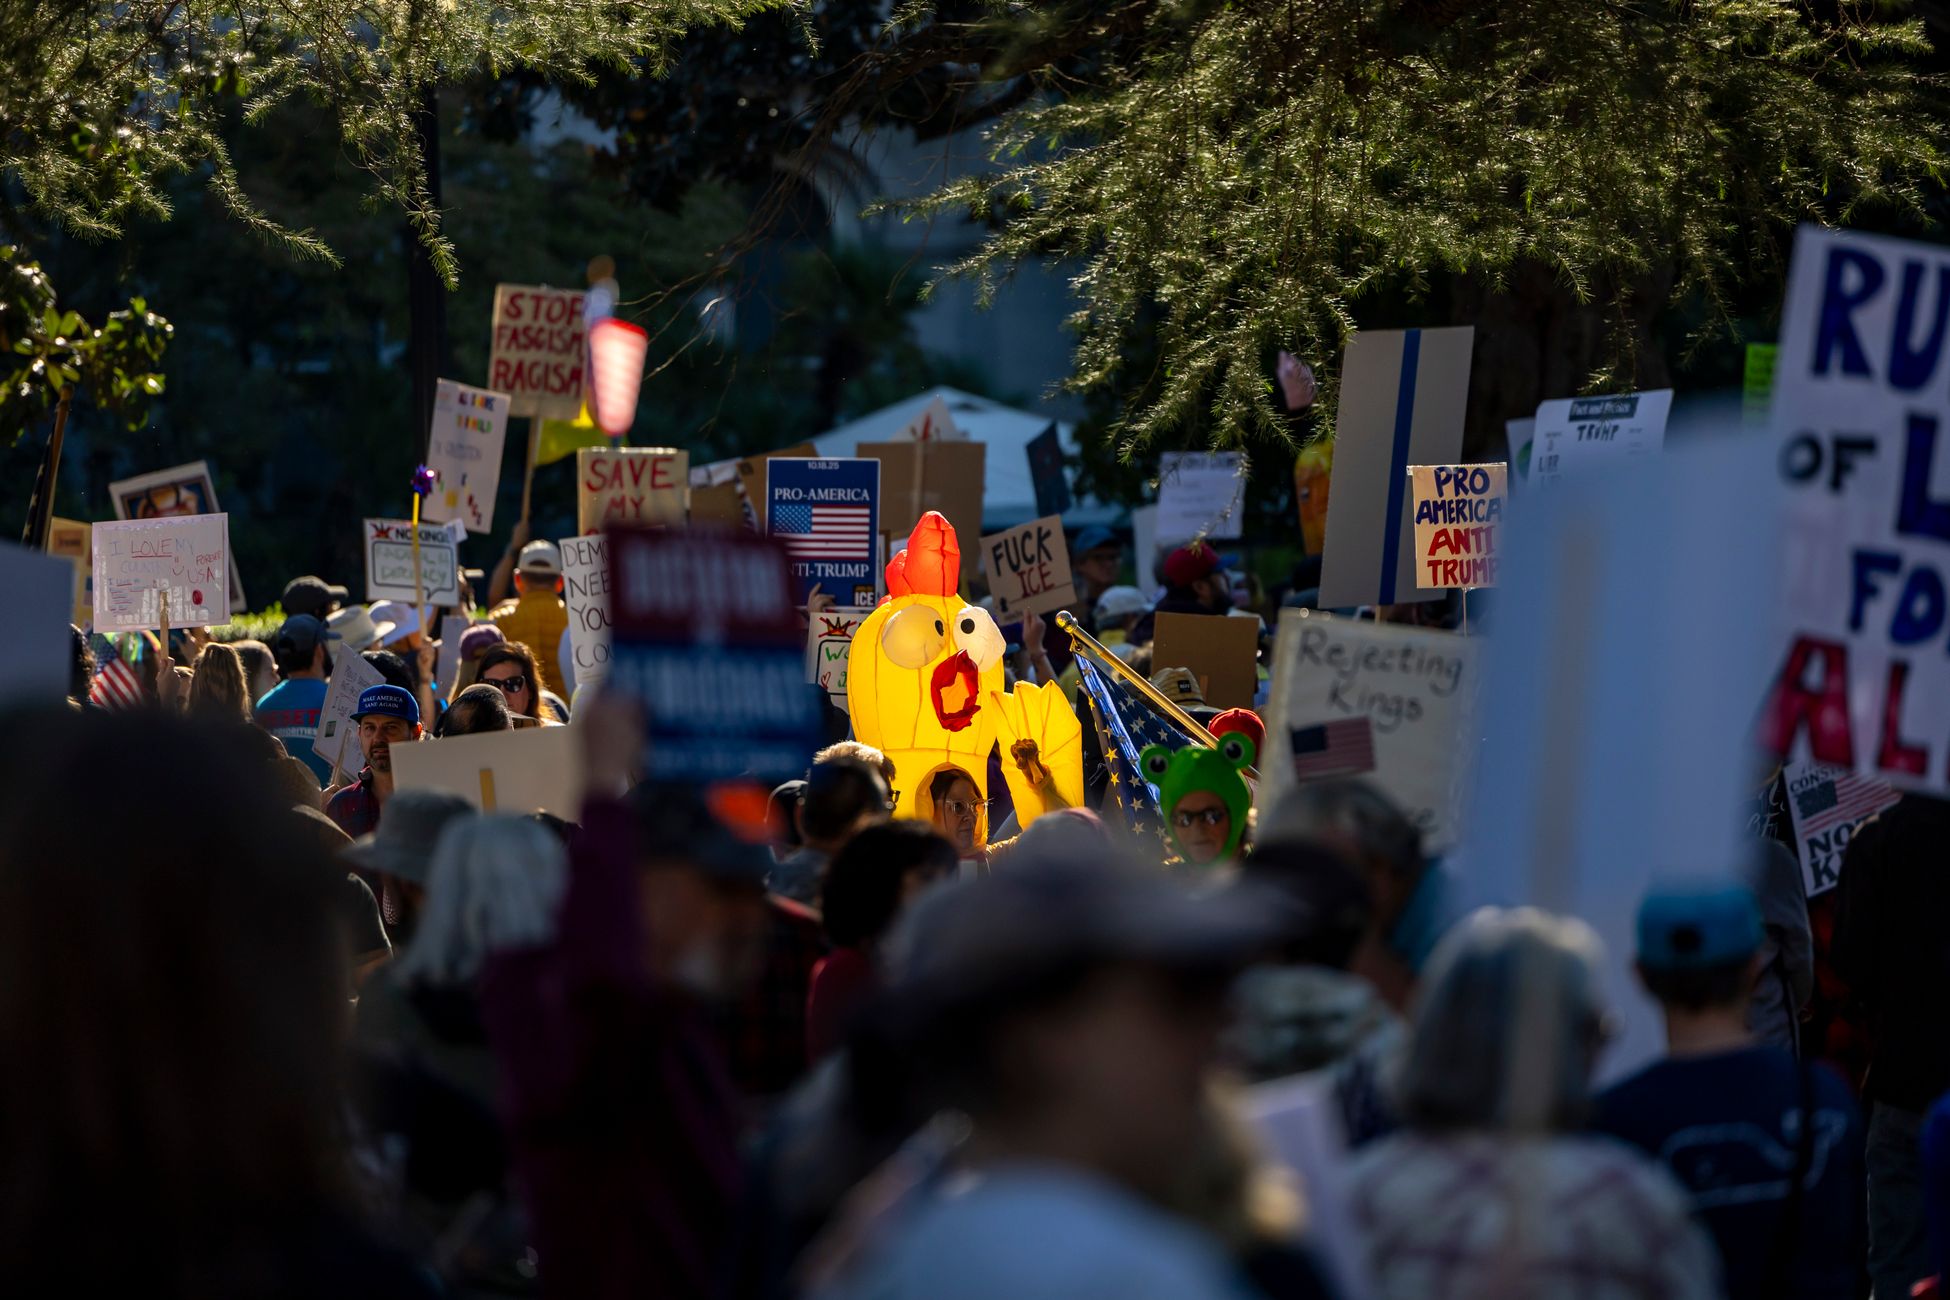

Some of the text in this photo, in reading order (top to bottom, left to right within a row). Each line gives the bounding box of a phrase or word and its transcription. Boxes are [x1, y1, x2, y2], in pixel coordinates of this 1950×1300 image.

[505, 292, 585, 326] STOP
[492, 357, 584, 398] RACISM
[1577, 424, 1620, 442] TRUMP
[586, 456, 676, 493] SAVE
[808, 461, 840, 470] 10.18.25
[1778, 432, 1878, 492] OF
[774, 487, 870, 501] PRO-AMERICA
[1434, 466, 1491, 498] PRO
[605, 496, 646, 520] MY
[1416, 497, 1502, 525] AMERICA
[110, 541, 124, 556] I
[131, 538, 172, 556] LOVE
[992, 526, 1053, 577] FUCK
[1428, 525, 1497, 556] ANTI
[187, 566, 216, 584] USA
[789, 562, 870, 578] NTI-TRUMP
[1017, 562, 1055, 598] ICE
[1427, 557, 1500, 587] TRUMP
[855, 591, 874, 605] ICE
[1847, 546, 1950, 660] FO
[1300, 625, 1463, 698] Rejecting
[376, 695, 403, 703] AMERICA
[378, 701, 399, 709] AGAIN
[1328, 677, 1424, 734] Kings
[1757, 632, 1950, 778] AL
